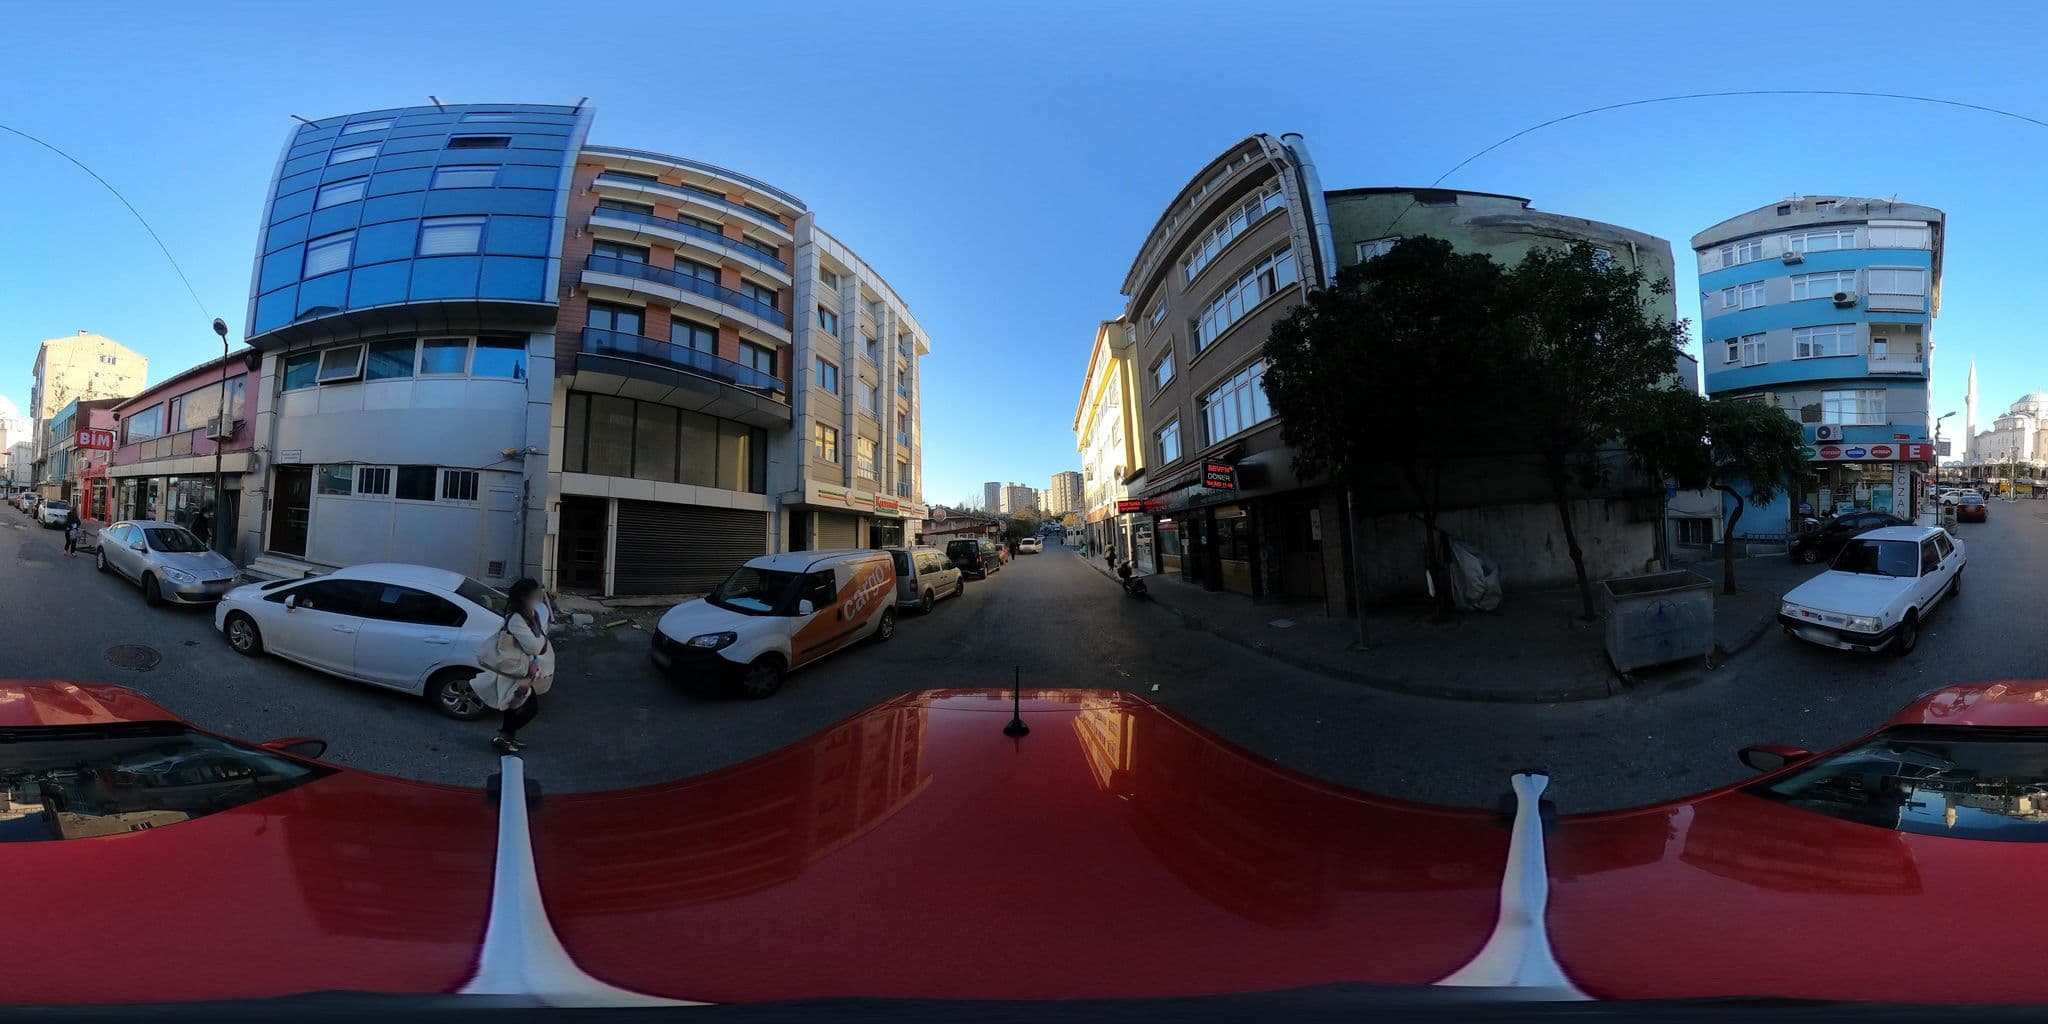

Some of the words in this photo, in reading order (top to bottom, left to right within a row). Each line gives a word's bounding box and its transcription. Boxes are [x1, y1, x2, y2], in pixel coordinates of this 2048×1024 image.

[80, 431, 110, 447] BİM
[1910, 445, 1920, 459] E
[1897, 464, 1906, 520] ECZAN
[844, 565, 884, 620] cargo
